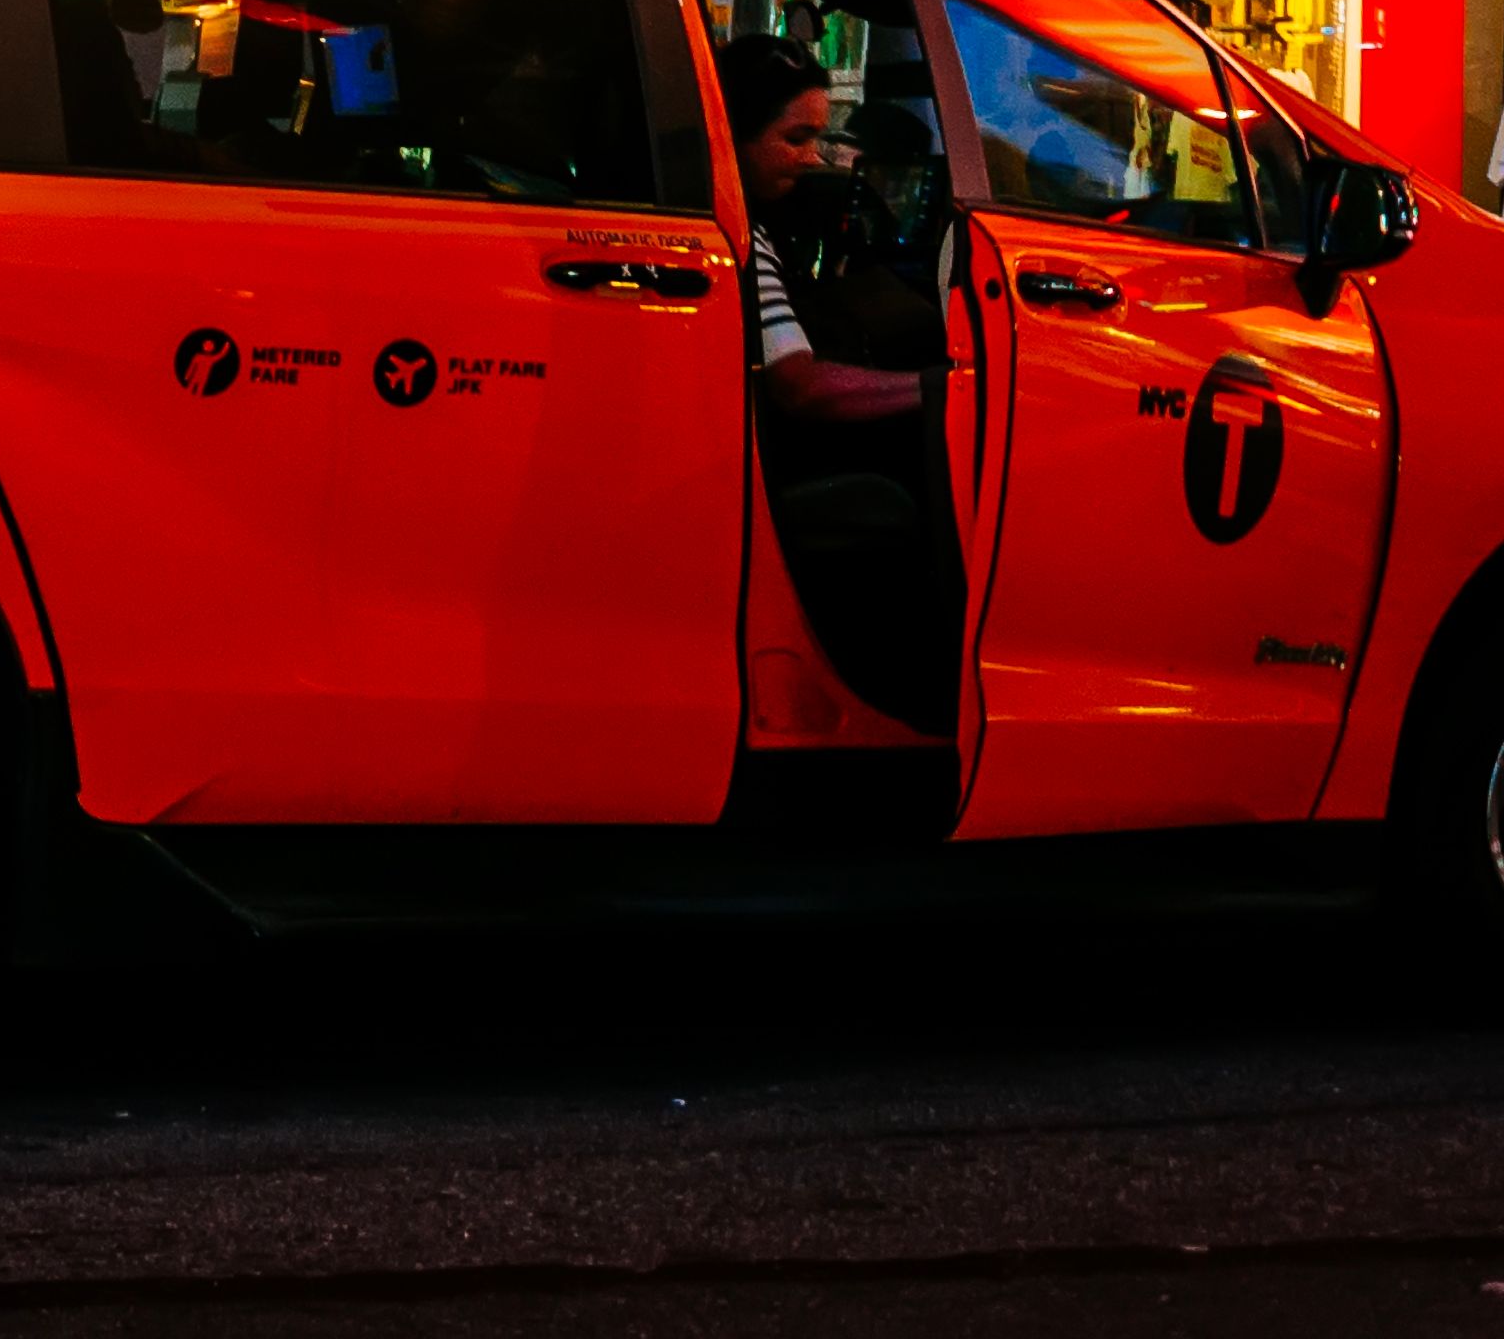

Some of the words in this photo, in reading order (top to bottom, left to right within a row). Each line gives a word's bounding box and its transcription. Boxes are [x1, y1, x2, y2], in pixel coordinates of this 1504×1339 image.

[566, 228, 653, 247] AUTOMATIC
[252, 347, 342, 368] METERED
[448, 357, 494, 376] FLAT
[499, 359, 547, 379] FARE
[250, 367, 299, 385] FARE
[447, 379, 482, 395] JFK
[1137, 385, 1187, 420] NYC
[1211, 392, 1264, 519] T
